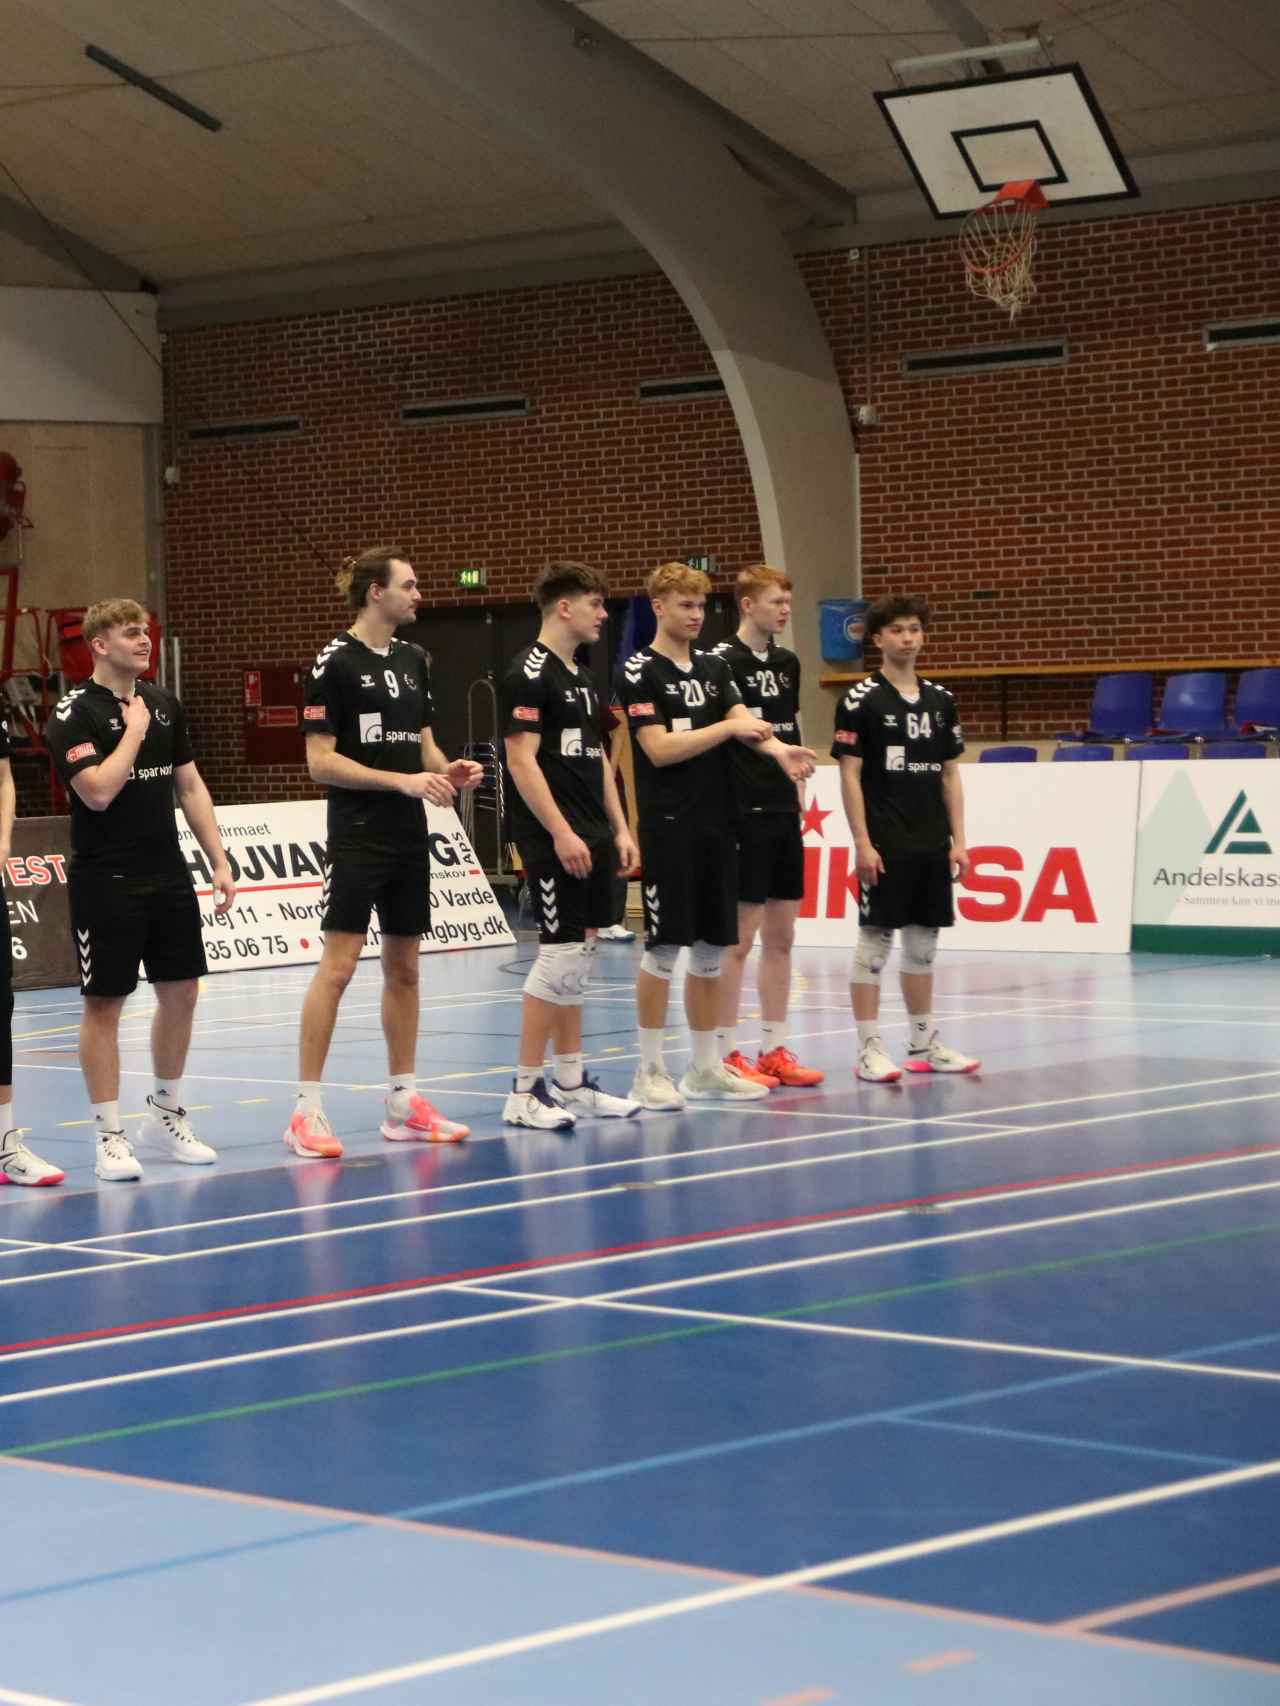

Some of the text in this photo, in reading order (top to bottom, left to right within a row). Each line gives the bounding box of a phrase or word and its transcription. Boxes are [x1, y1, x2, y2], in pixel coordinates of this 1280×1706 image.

[383, 669, 400, 699] 9
[679, 678, 706, 707] 20
[755, 670, 780, 698] 23
[905, 711, 933, 740] 64
[427, 832, 461, 868] G
[451, 831, 476, 865] APS
[0, 854, 68, 889] EST
[430, 869, 467, 880] nskov
[1152, 866, 1280, 888] Andelskas
[5, 899, 40, 925] EN
[236, 905, 259, 924] 11
[440, 886, 495, 908] Varde
[11, 936, 28, 960] 6
[205, 940, 232, 961] 35
[234, 937, 260, 958] 06
[262, 934, 289, 955] 75
